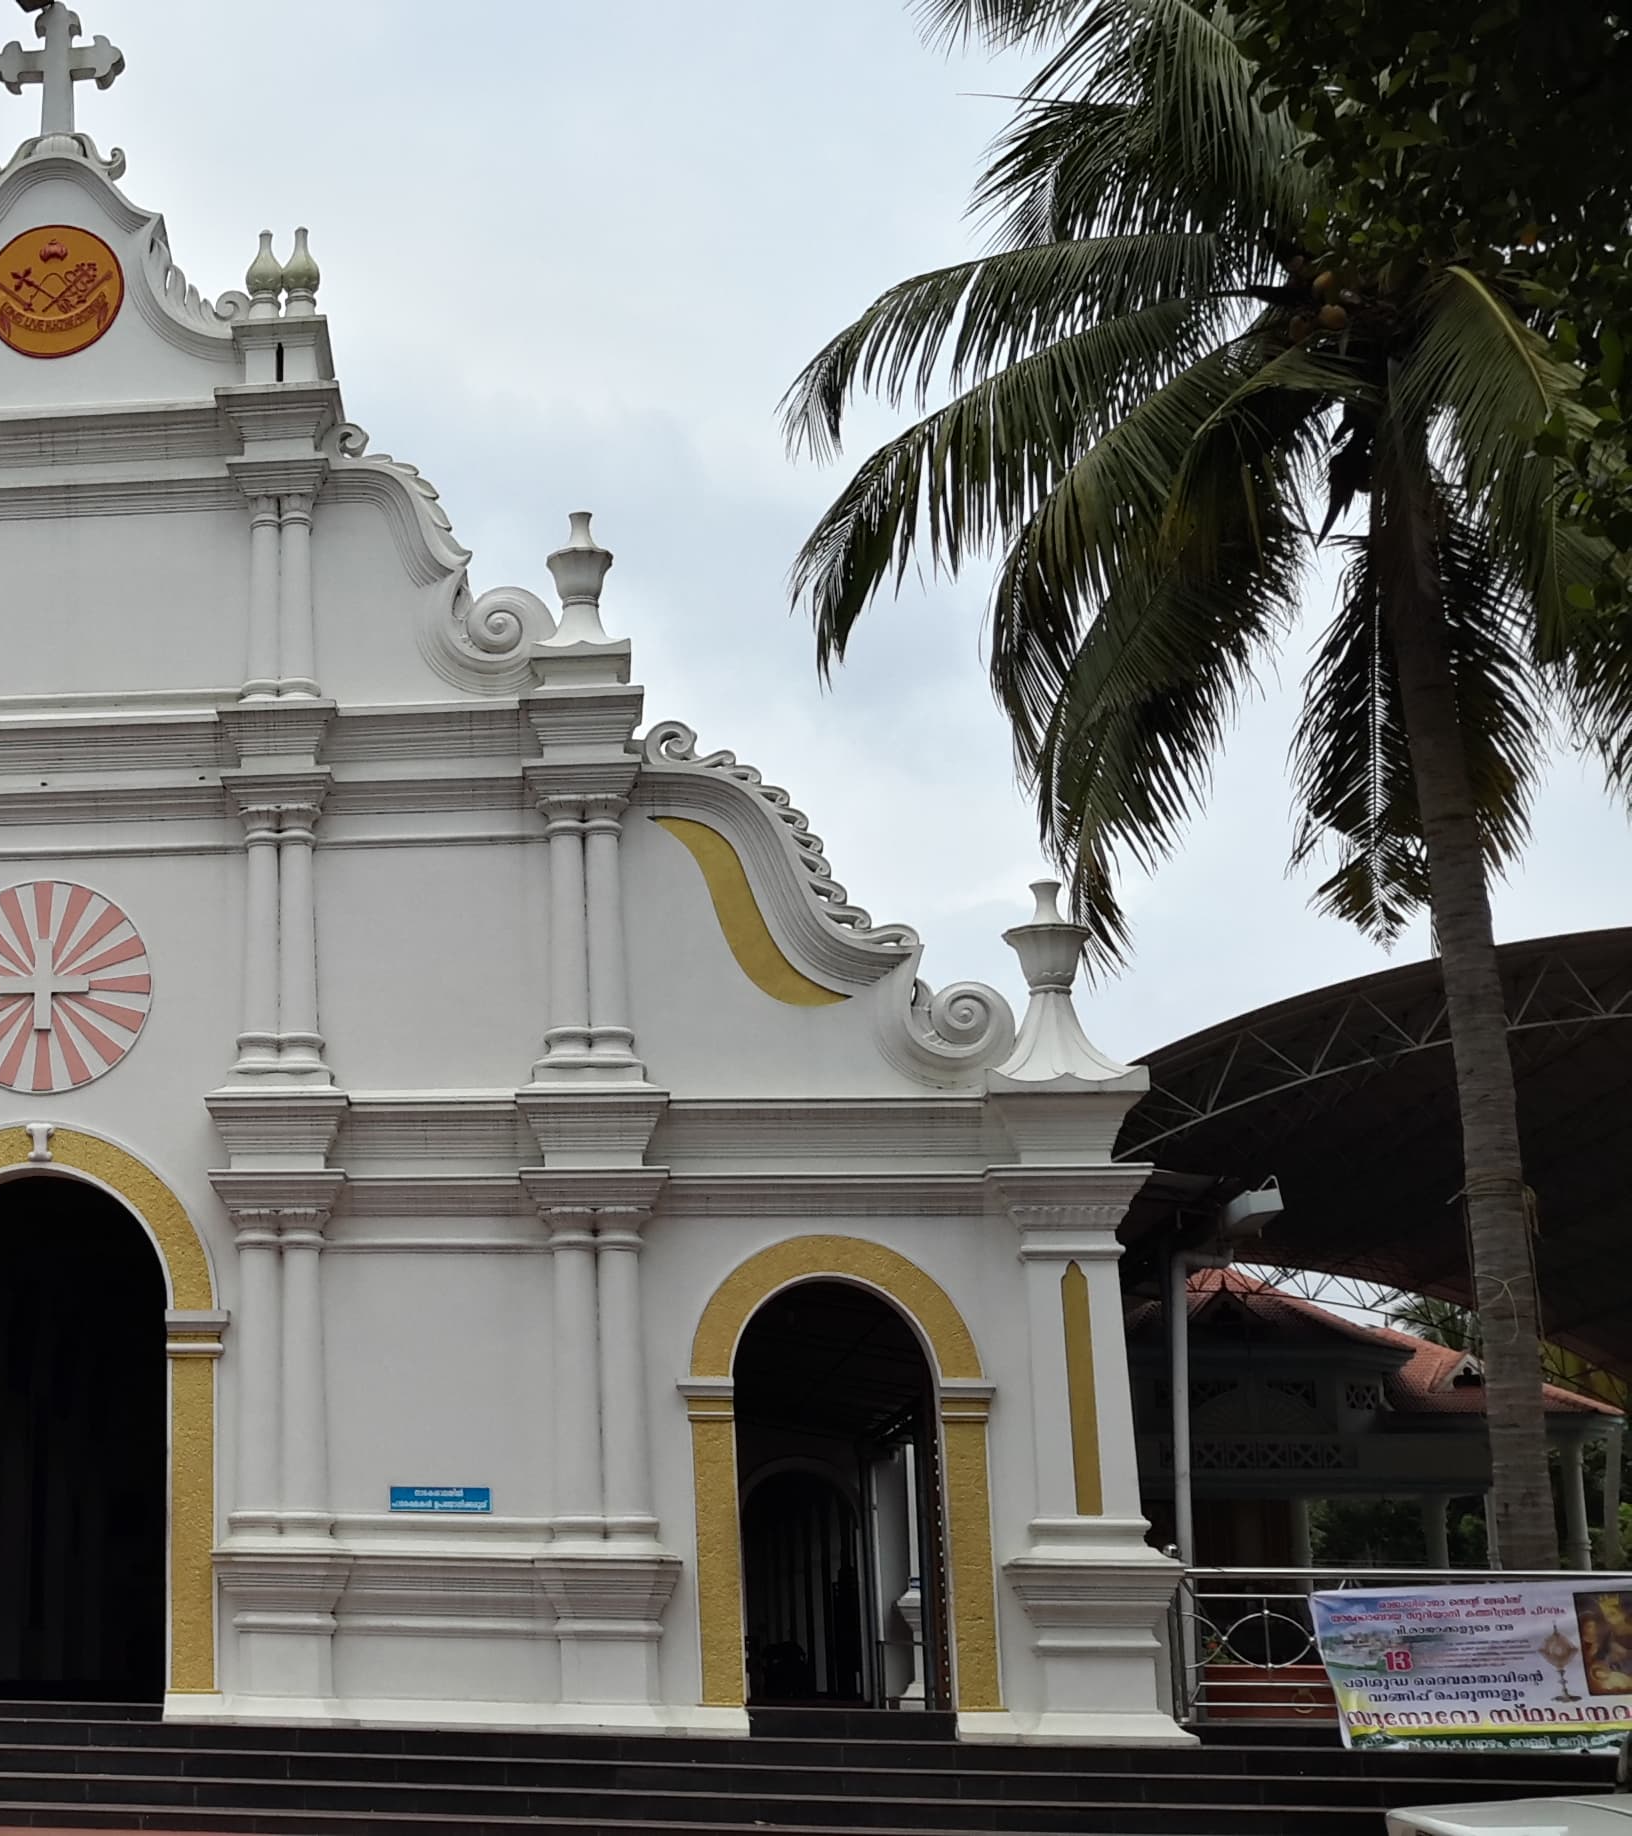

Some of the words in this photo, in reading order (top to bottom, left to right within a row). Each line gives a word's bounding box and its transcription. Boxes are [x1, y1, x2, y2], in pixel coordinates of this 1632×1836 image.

[1383, 1650, 1414, 1673] 13
[1342, 1674, 1409, 1690] പരിശുദ്ധ
[1433, 1688, 1525, 1703] പെരുന്നാളും
[1346, 1708, 1481, 1728] സുനോറോ
